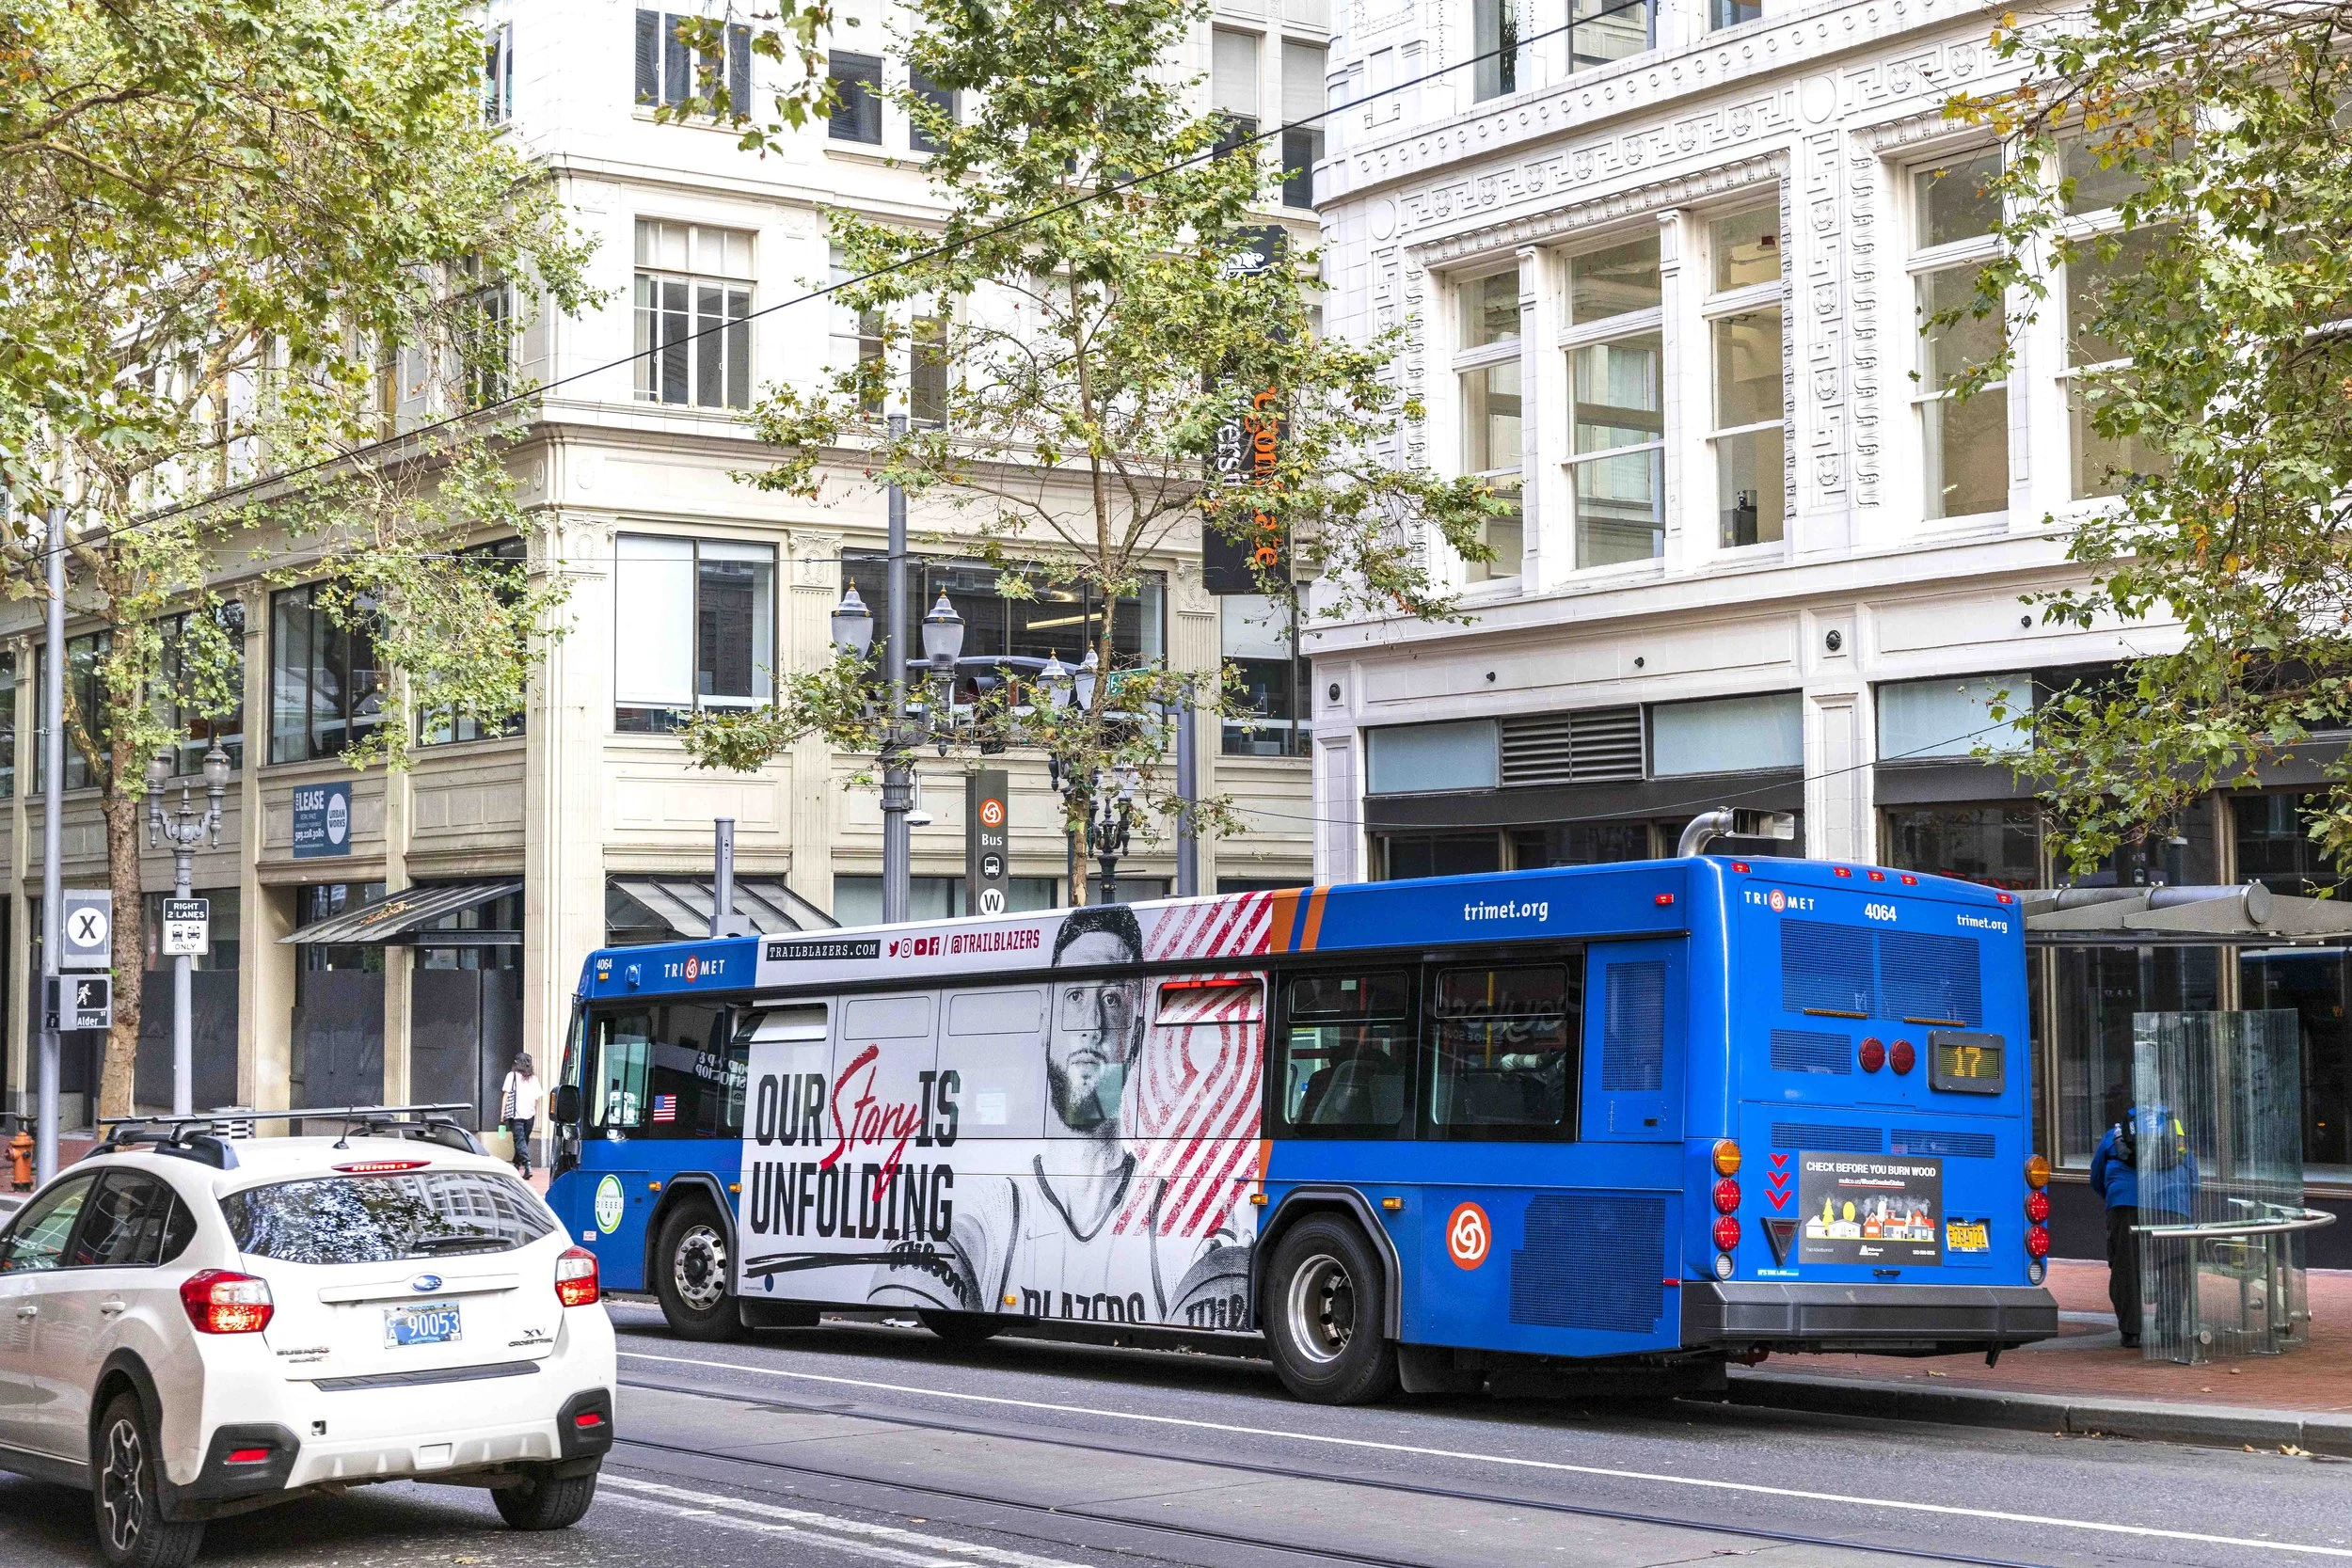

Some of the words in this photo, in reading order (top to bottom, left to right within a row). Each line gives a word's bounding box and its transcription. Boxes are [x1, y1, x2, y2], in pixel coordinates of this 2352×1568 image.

[299, 790, 325, 811] LEASE
[328, 809, 346, 818] URBAN
[328, 819, 346, 828] WORKS
[981, 833, 1003, 846] Bus
[173, 902, 199, 911] RIGHT
[984, 894, 1000, 911] W
[1464, 900, 1549, 922] trimet.org
[176, 910, 205, 919] LANES
[1864, 902, 1897, 922] 4064
[78, 915, 97, 939] X
[1956, 913, 2009, 934] trimet.org
[950, 928, 1041, 954] @TRAILBLAZERS
[770, 943, 877, 958] TRAILBLAZERS.COM
[596, 958, 612, 970] 4064
[77, 1016, 99, 1026] Alder
[1954, 1046, 1981, 1078] 17
[755, 1073, 826, 1147] OUR
[819, 1043, 926, 1203] Story
[915, 1069, 961, 1148] IS
[1806, 1161, 1835, 1173] CHECK
[1836, 1163, 1869, 1174] BEFORE
[1869, 1164, 1887, 1175] YOU
[1888, 1165, 1910, 1176] BURN
[1911, 1166, 1936, 1178] WOOD
[596, 1200, 622, 1210] DIESEL
[751, 1161, 954, 1243] UNFOLDING
[407, 1311, 461, 1338] 90053
[523, 1327, 546, 1338] XV
